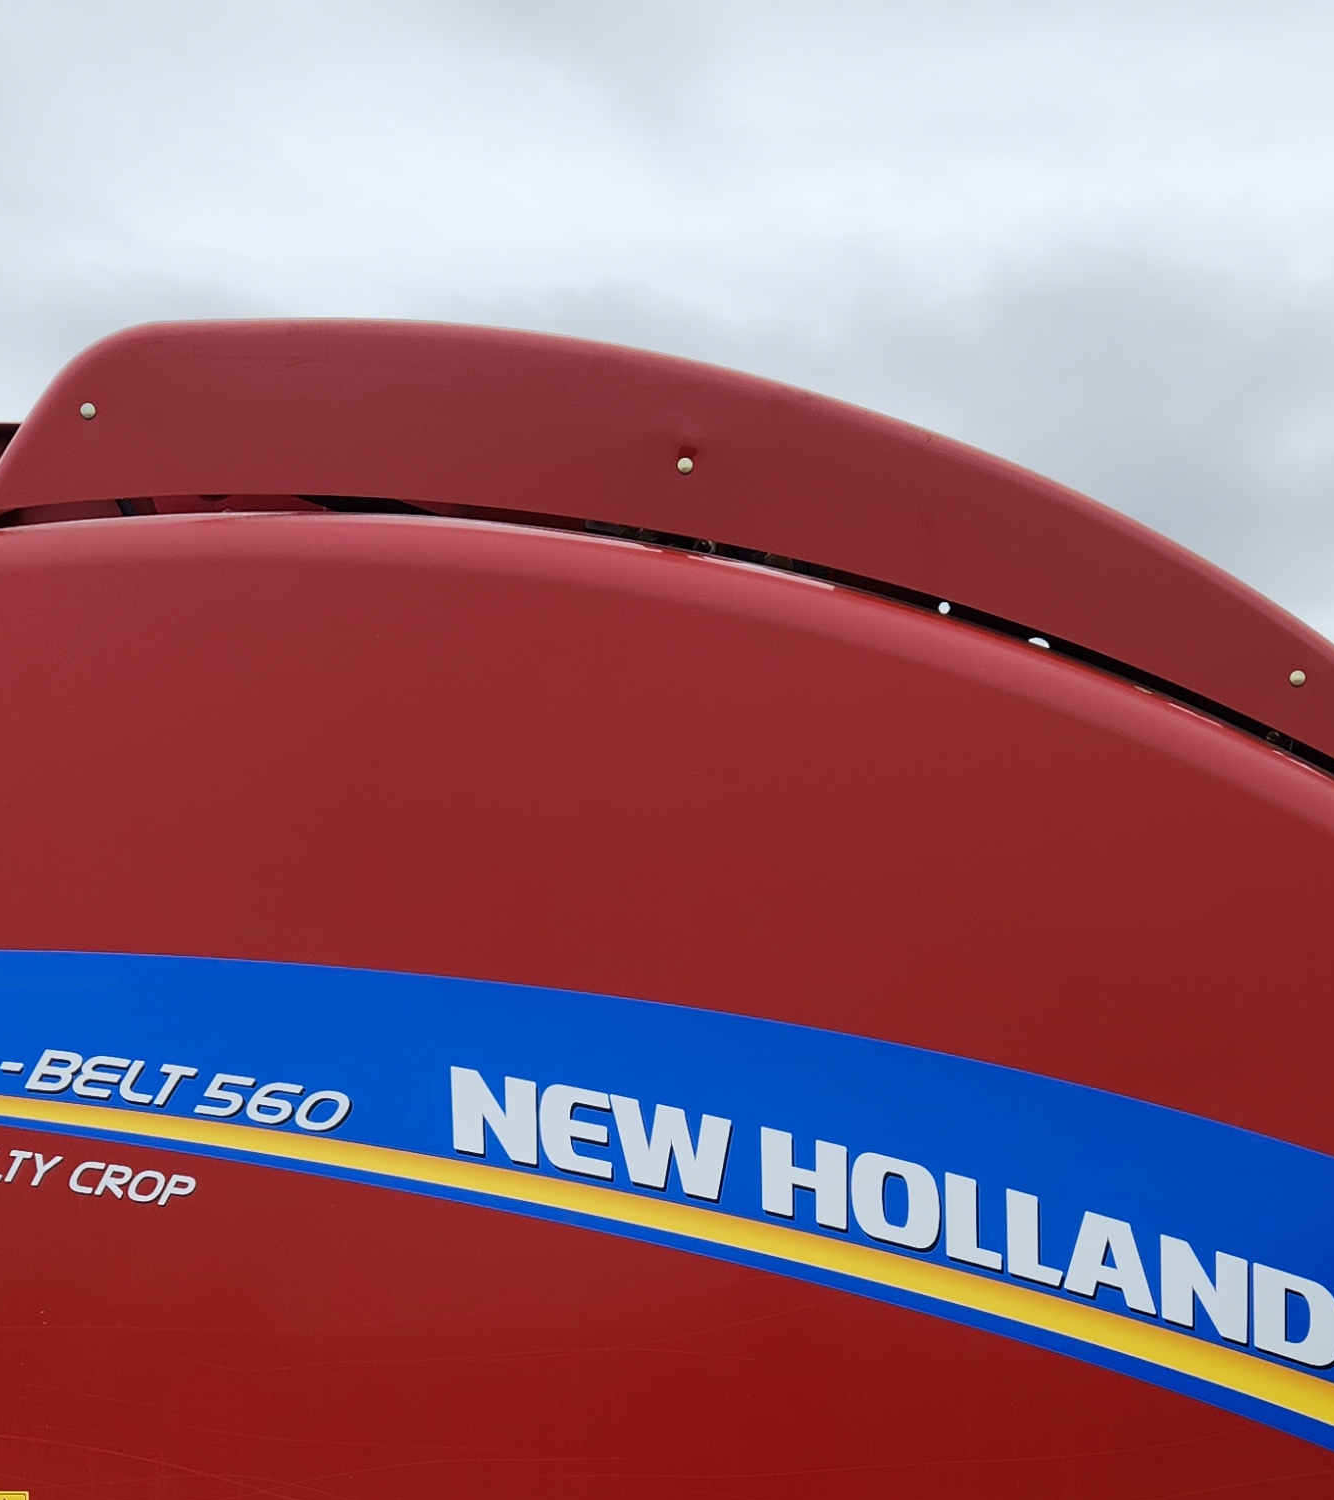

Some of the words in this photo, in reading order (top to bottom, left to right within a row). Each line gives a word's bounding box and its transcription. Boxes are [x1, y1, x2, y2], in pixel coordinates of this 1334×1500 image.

[194, 1073, 350, 1133] 560
[450, 1066, 733, 1201] NEW
[69, 1161, 196, 1206] CROP
